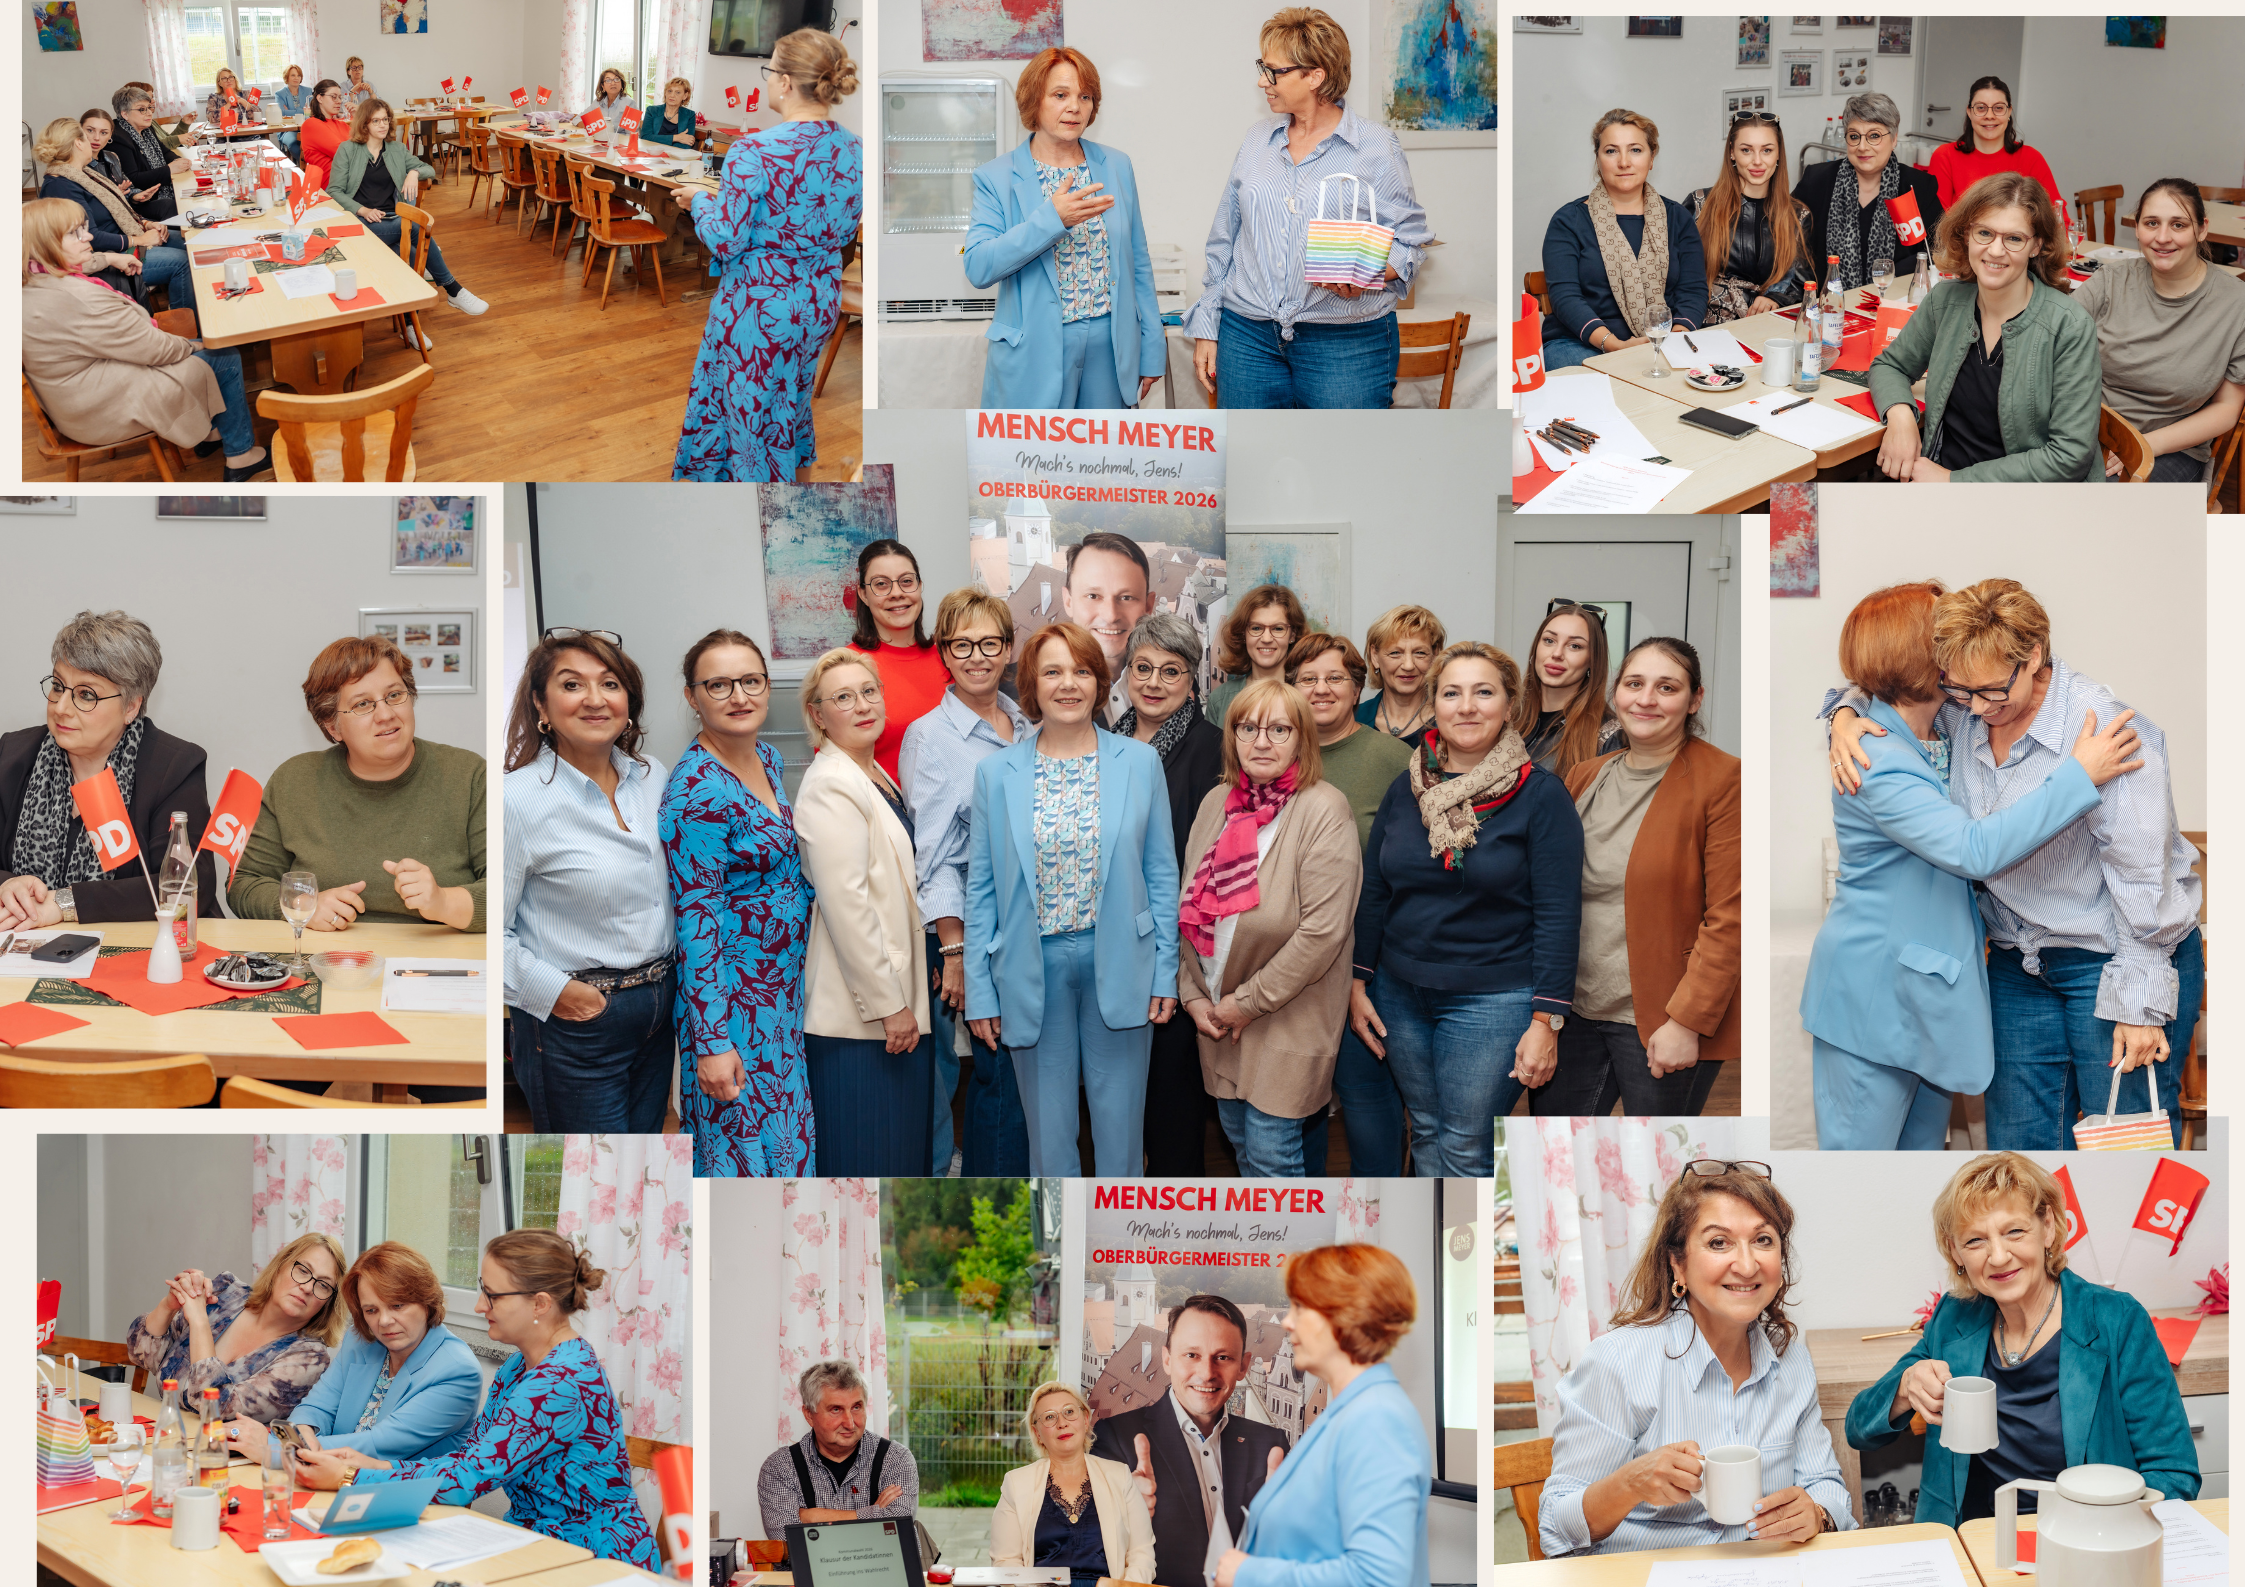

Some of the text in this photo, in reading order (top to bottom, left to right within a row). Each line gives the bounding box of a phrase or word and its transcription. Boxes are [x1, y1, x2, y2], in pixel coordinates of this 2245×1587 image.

[514, 95, 529, 106] SPD
[225, 124, 237, 134] SP
[586, 119, 605, 134] SPD
[294, 196, 304, 220] SP
[977, 412, 1217, 452] MENSCH MEYER
[1015, 450, 1183, 479] Mach's nochmal, Jens!
[978, 480, 1217, 509] OBERBÜRGERMEISTER 2026
[1094, 1185, 1326, 1214] MENSCH MEYER
[1126, 1219, 1289, 1242] Mach's nochmal, Jens!
[1453, 1233, 1471, 1246] JENS
[1453, 1242, 1471, 1252] MEYER
[1092, 1246, 1271, 1268] OBERBÜRGERMEISTER
[820, 1556, 841, 1564] Klausur
[853, 1552, 893, 1561] Kandidatinnen
[828, 1568, 856, 1577] Einführung
[865, 1566, 890, 1574] Wahlrecht
